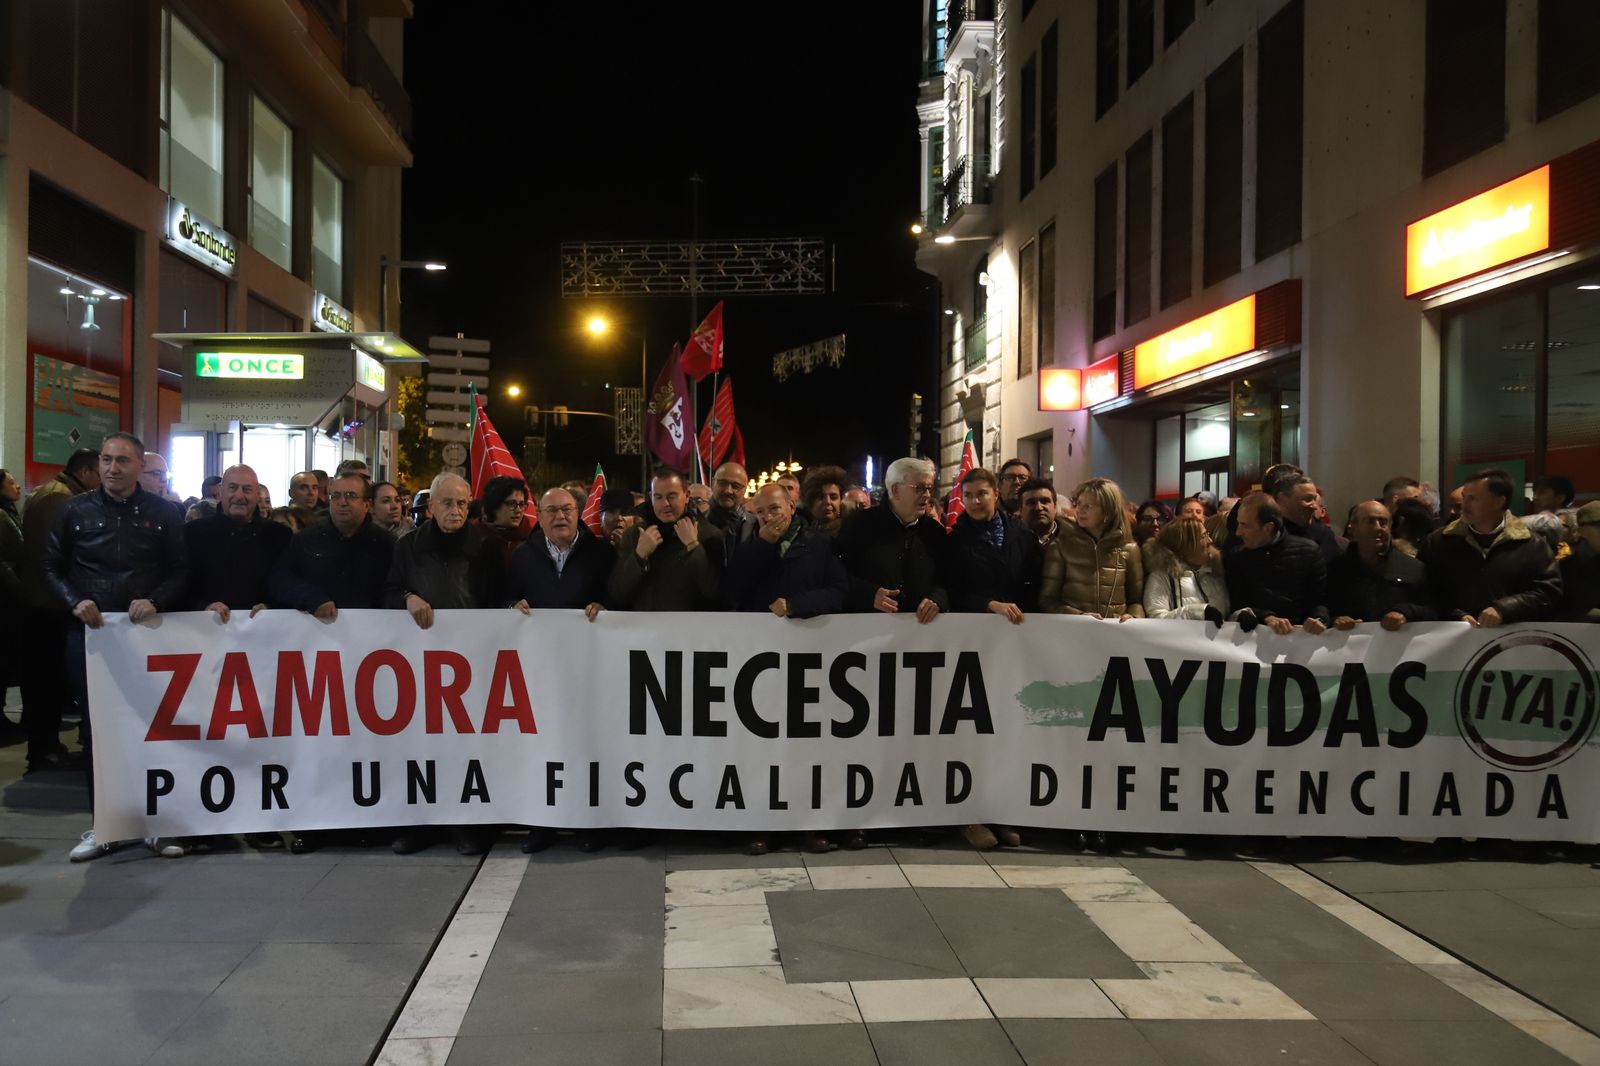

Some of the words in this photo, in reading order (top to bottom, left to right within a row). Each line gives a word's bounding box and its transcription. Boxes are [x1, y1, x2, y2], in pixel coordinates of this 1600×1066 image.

[228, 358, 295, 374] ONCE
[144, 648, 538, 742] ZAMORA
[628, 649, 995, 739] NECESITA
[1087, 656, 1428, 749] AYUDAS
[1475, 670, 1581, 732] ¡YA!
[146, 764, 290, 816] POR
[352, 759, 491, 808] UNA
[546, 760, 973, 811] FISCALIDAD
[1030, 764, 1569, 820] DIFERENCIADA
